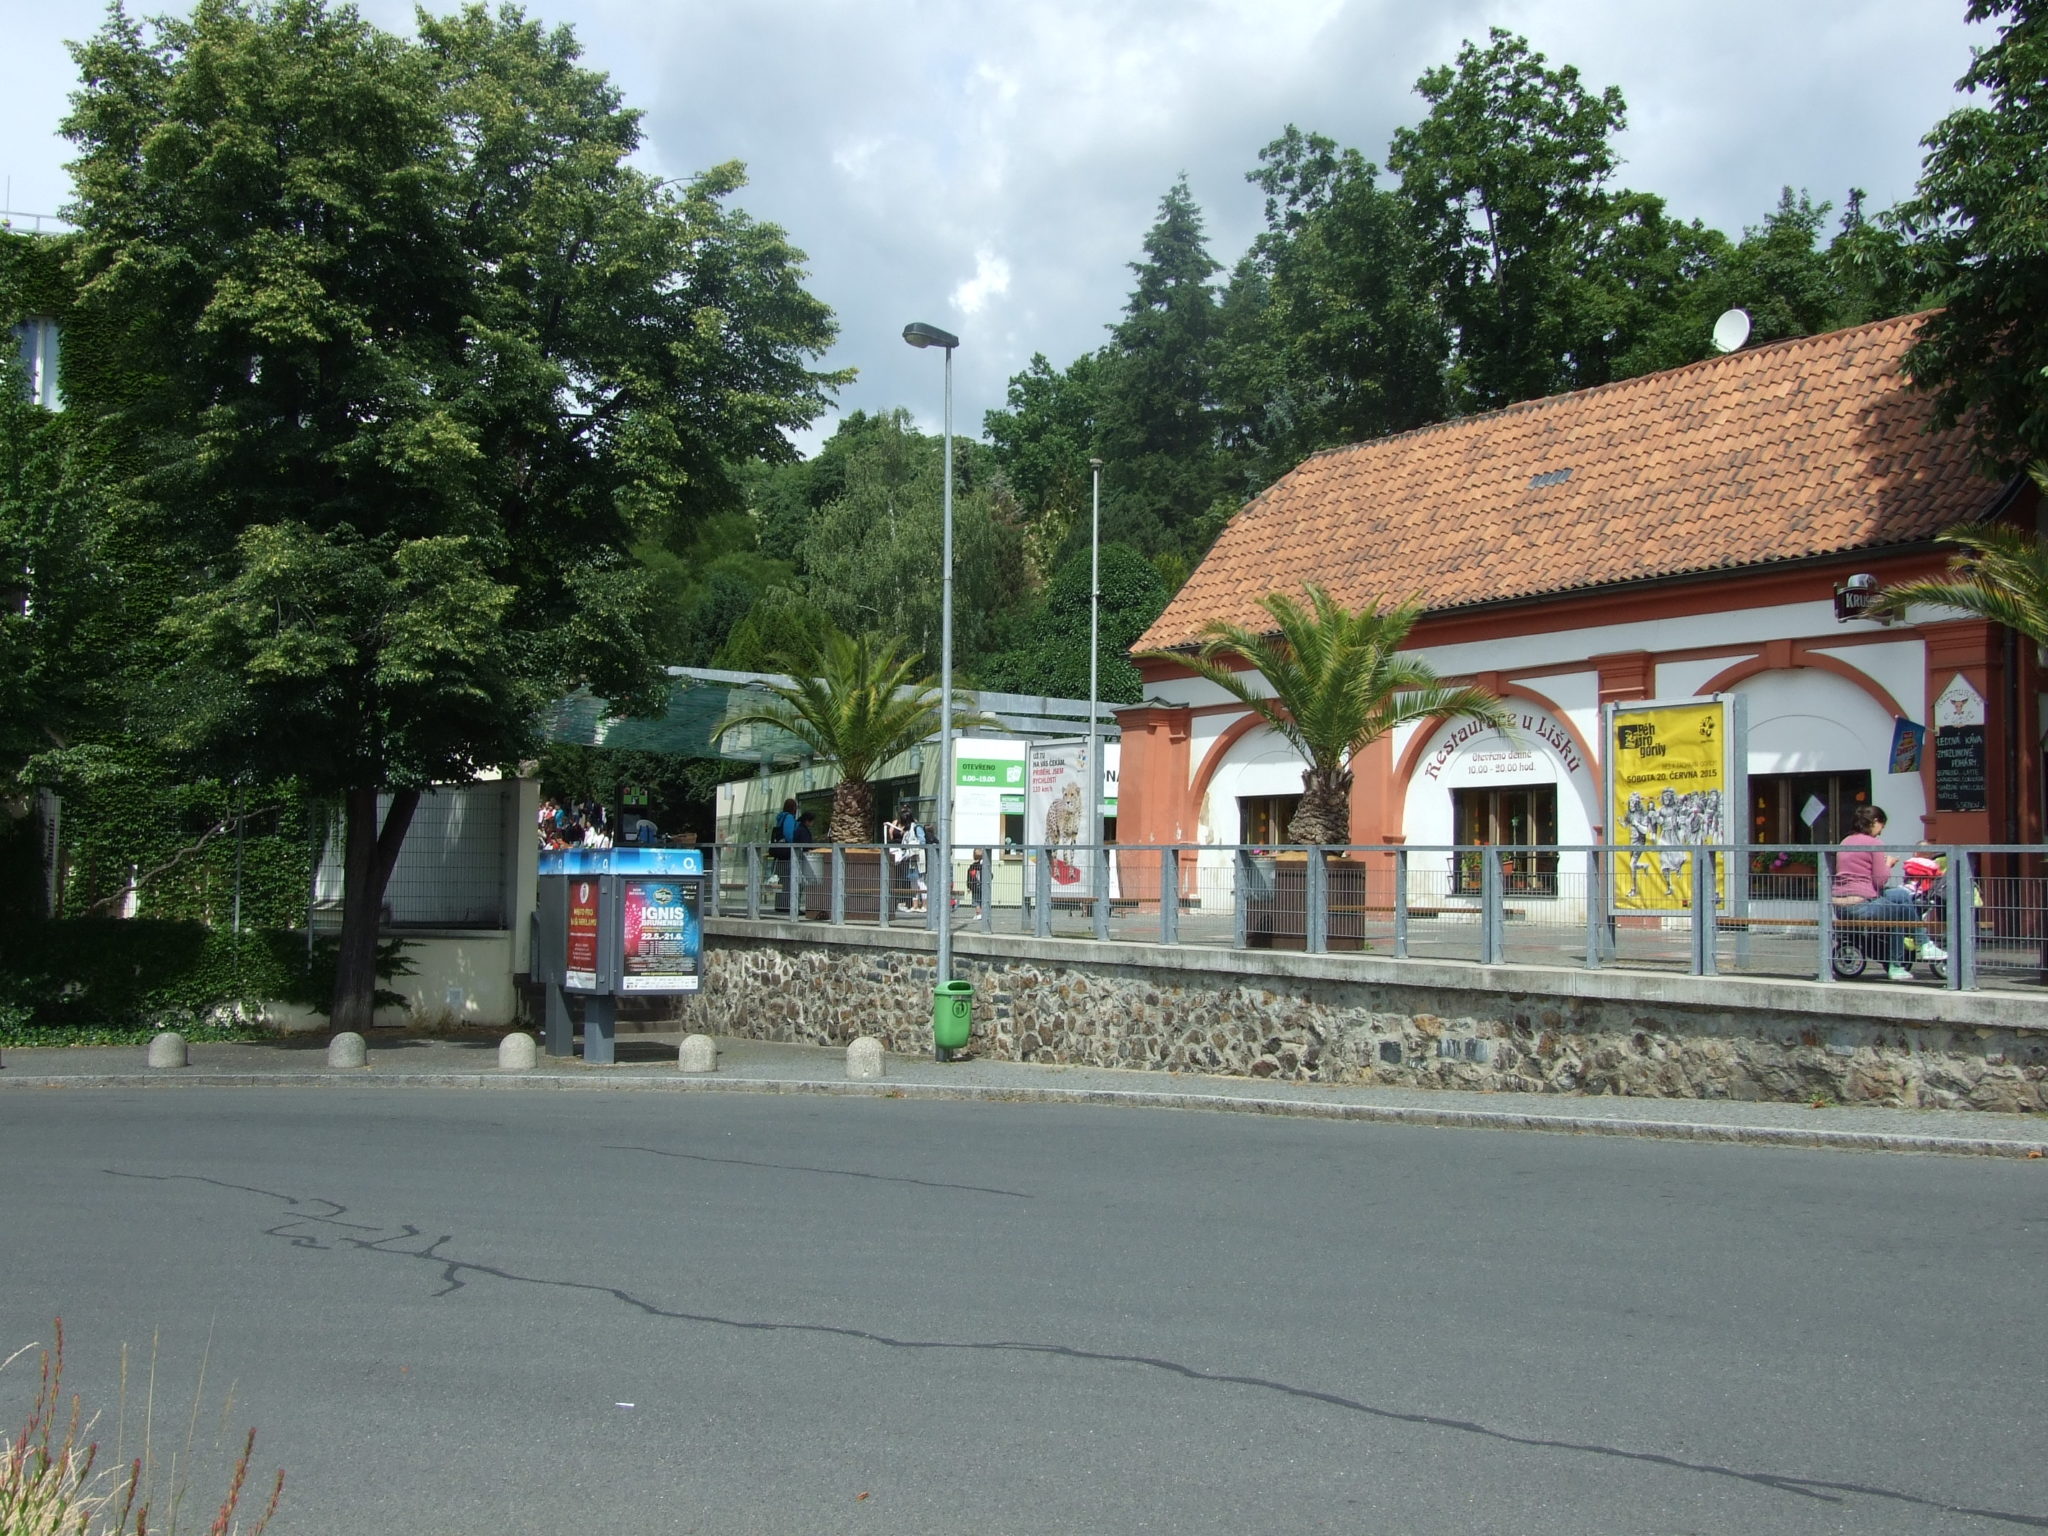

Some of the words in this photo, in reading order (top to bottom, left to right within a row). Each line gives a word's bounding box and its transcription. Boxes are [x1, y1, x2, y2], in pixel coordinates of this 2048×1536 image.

[1522, 715, 1533, 730] u
[962, 763, 996, 771] OTEVŘENO
[1626, 772, 1656, 784] SOBOTA
[1700, 769, 1718, 779] 2015
[641, 906, 685, 920] IGNIS
